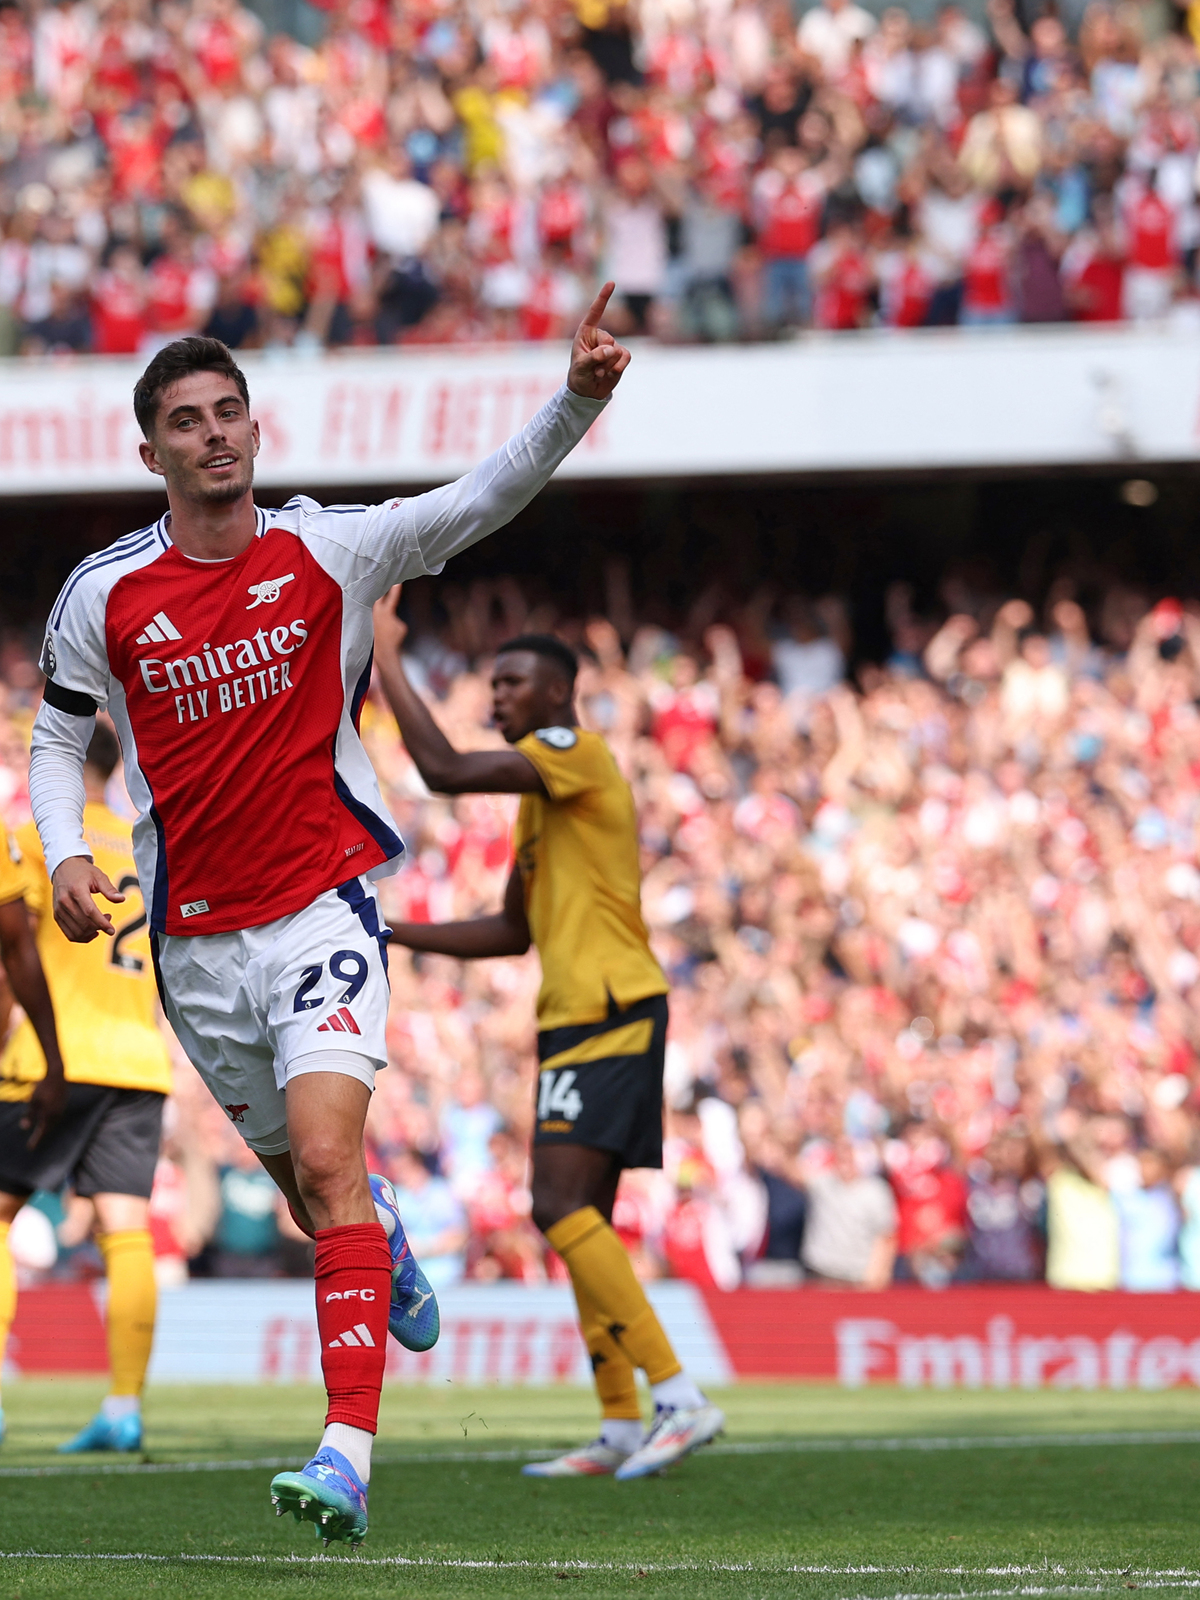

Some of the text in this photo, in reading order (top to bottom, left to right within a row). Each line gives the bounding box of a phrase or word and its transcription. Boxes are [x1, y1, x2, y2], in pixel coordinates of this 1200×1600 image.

[321, 377, 410, 460] FLY
[139, 619, 308, 693] Emirates
[175, 661, 294, 724] FLY BETTER
[293, 949, 369, 1014] 29
[537, 1069, 583, 1121] 14
[326, 1288, 376, 1303] AFC
